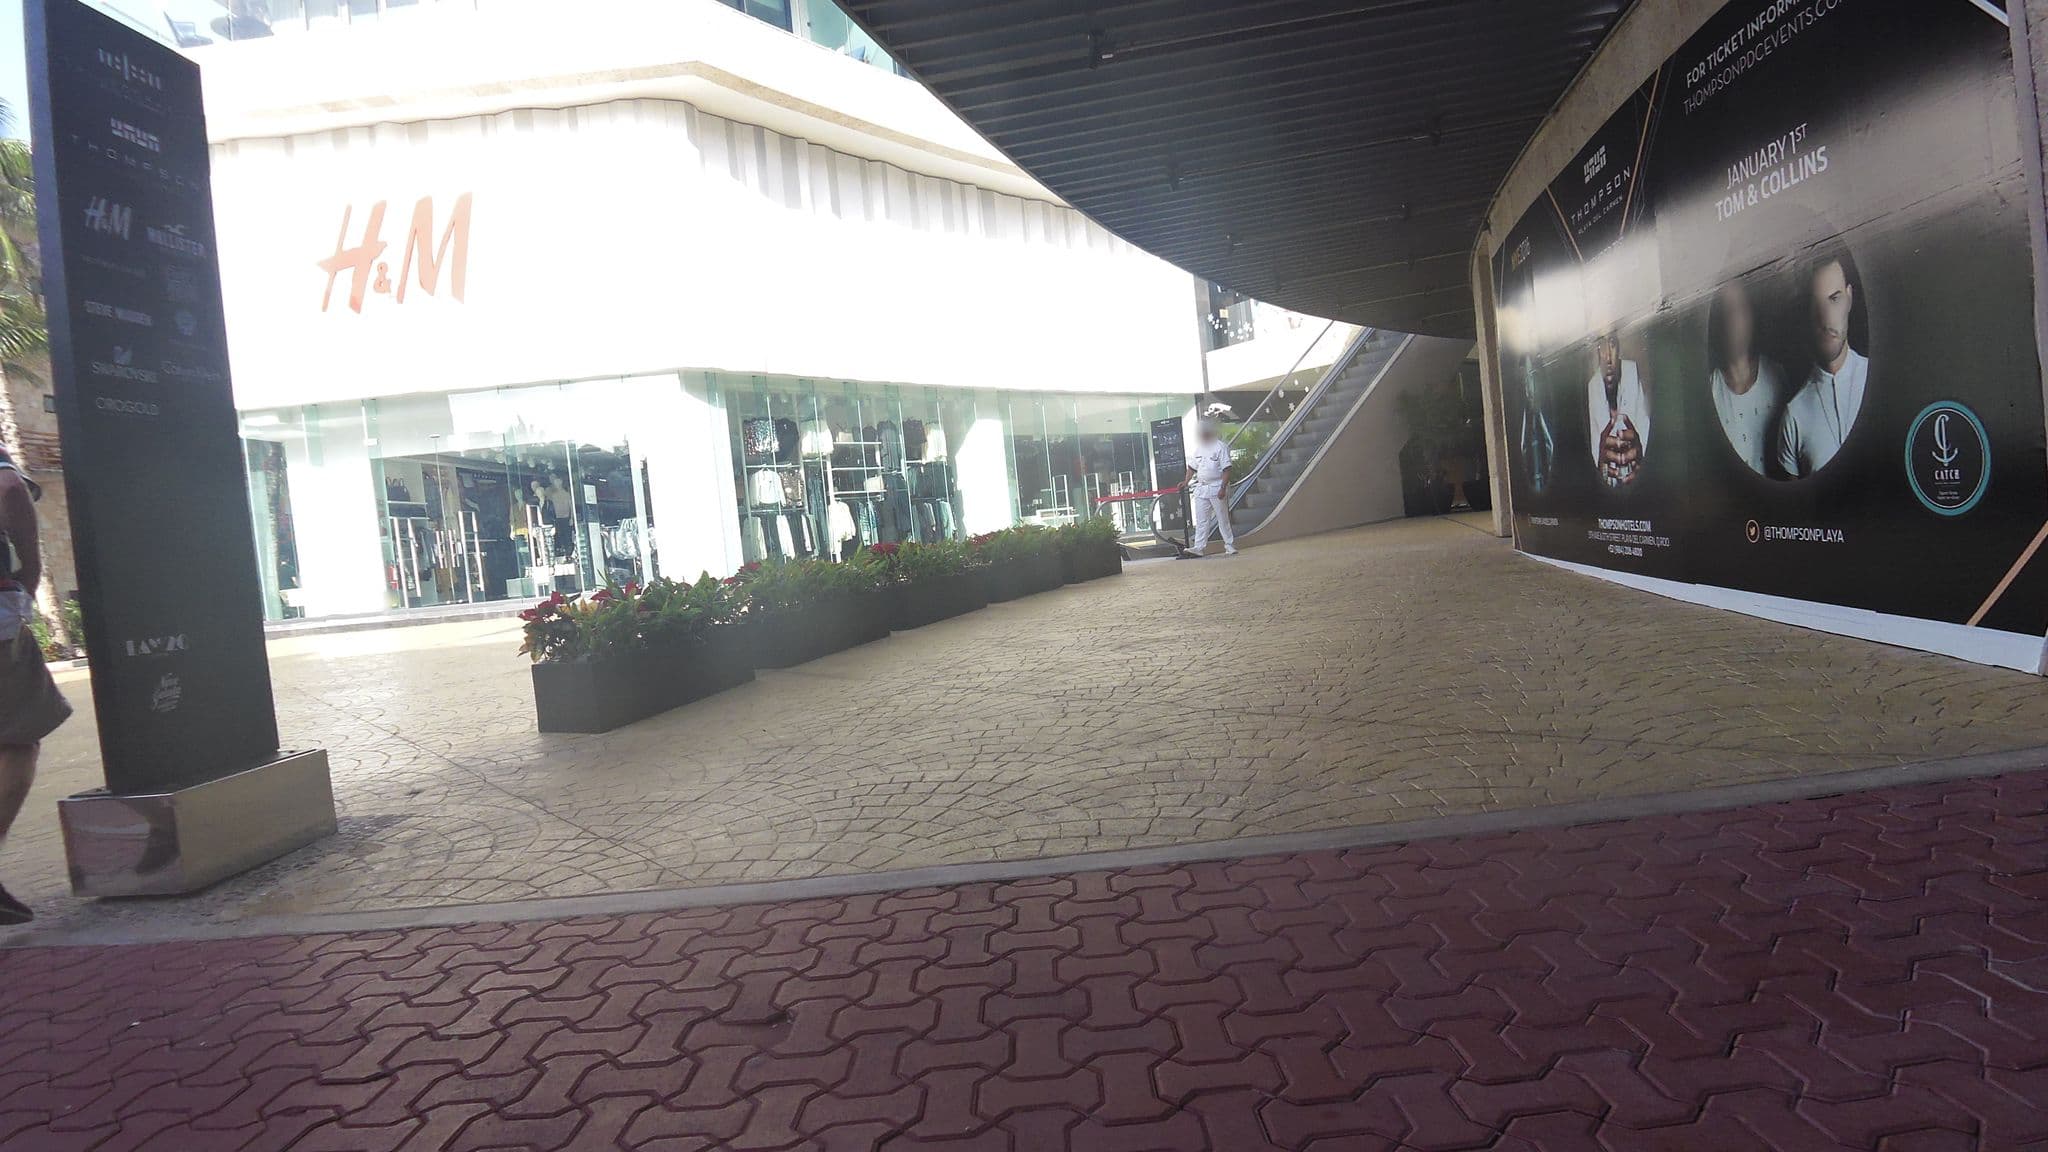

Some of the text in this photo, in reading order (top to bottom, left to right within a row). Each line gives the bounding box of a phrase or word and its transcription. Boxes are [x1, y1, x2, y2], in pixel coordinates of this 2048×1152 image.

[1683, 0, 1842, 115] THOMPSONPDCEVENTS.C
[1686, 0, 1800, 88] FOR TICKET INFOR
[1715, 146, 1828, 221] TOM & COLLINS
[1727, 122, 1808, 190] JANUARY 1ST
[84, 196, 132, 241] H&M
[1571, 166, 1631, 225] THOMPSON
[316, 191, 473, 314] H&M
[1934, 469, 1961, 480] CATCH
[1764, 525, 1845, 543] @THOMPSONPLAYA
